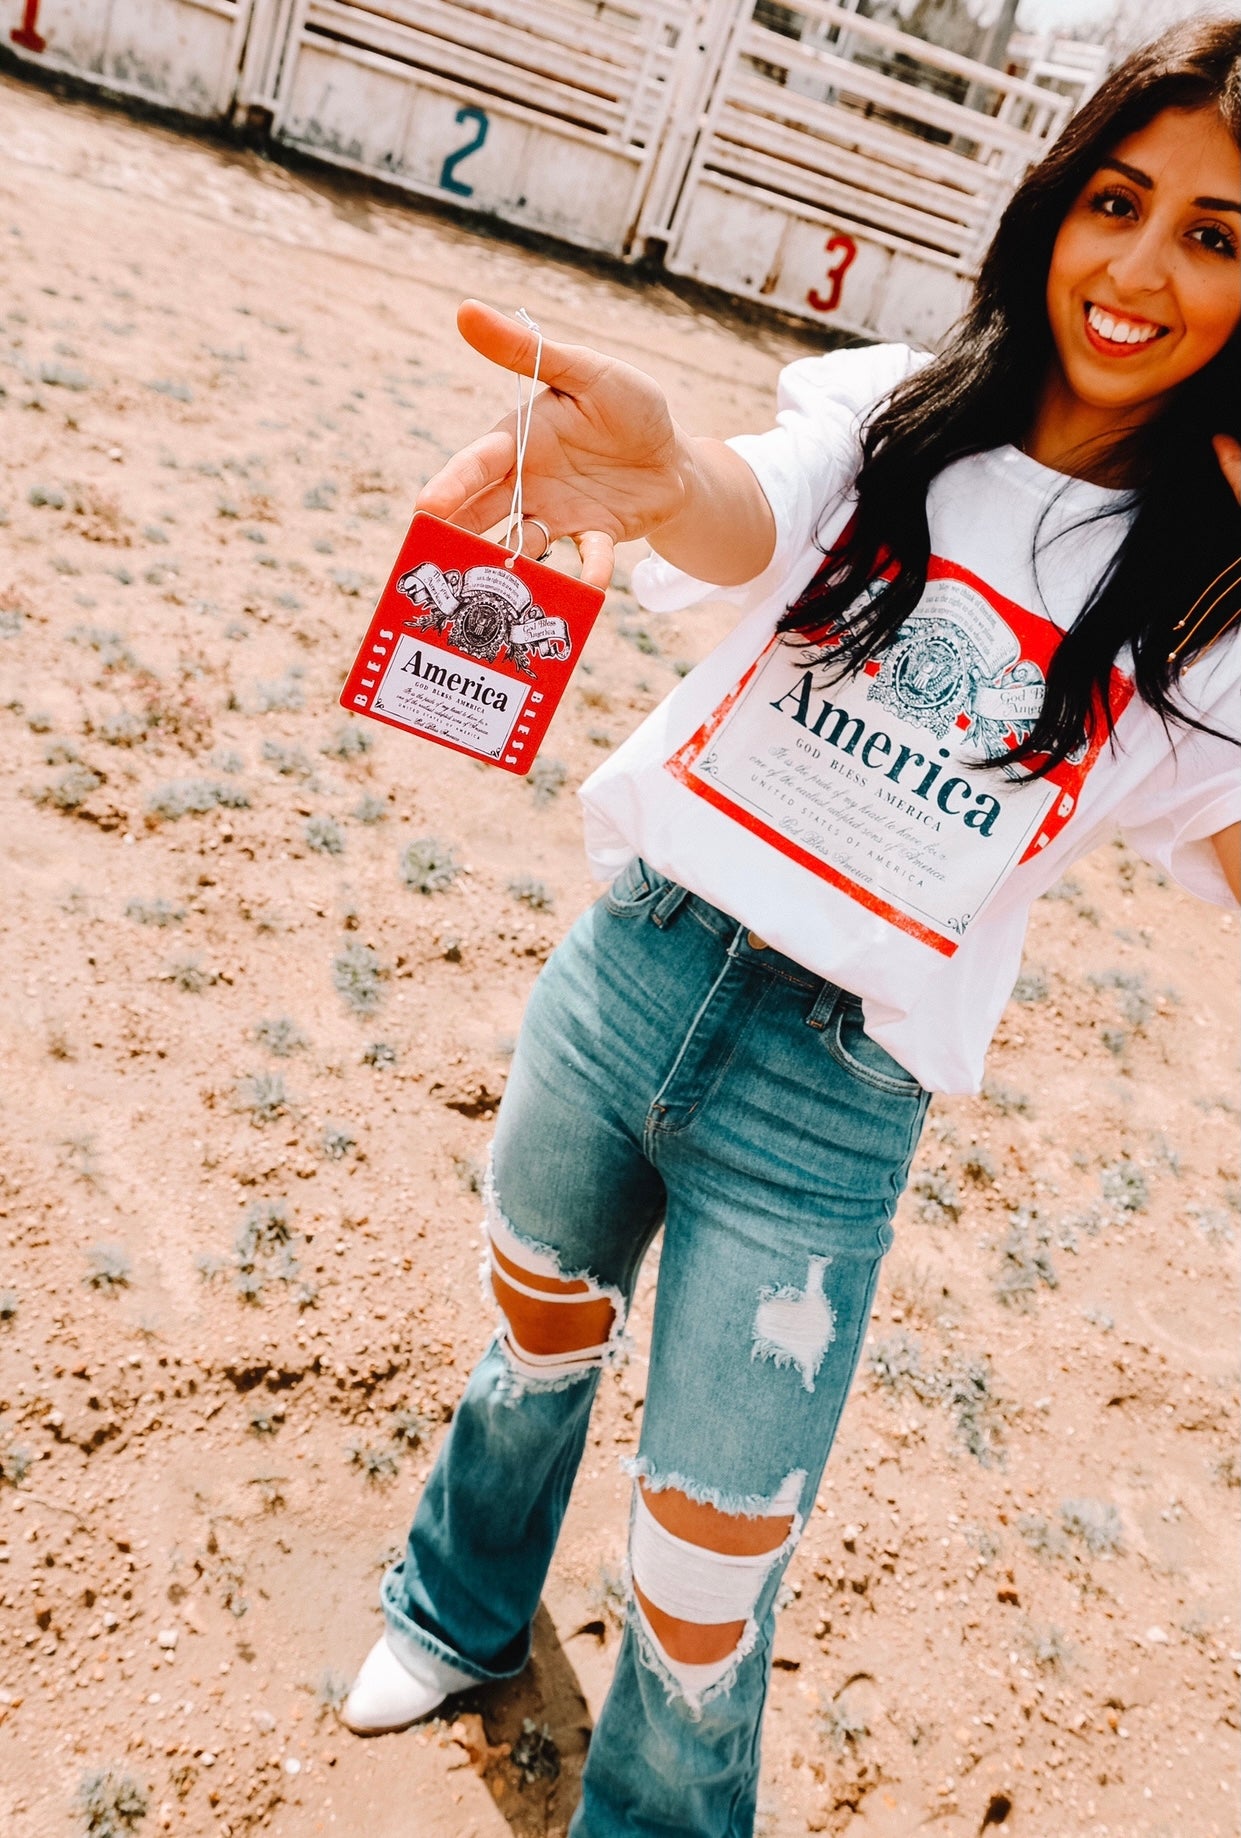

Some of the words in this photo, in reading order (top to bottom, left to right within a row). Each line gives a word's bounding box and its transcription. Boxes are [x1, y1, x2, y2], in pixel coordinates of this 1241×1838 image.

[440, 105, 490, 197] 2
[807, 235, 858, 312] 3
[353, 628, 394, 708] BLESS
[401, 650, 507, 713] America
[414, 681, 429, 691] GOD
[432, 688, 452, 700] BLESS
[456, 698, 485, 714] AMERICA
[1000, 689, 1026, 704] God
[505, 690, 544, 765] BLESS
[1003, 703, 1042, 717] Amer
[769, 670, 1002, 838] America
[795, 738, 821, 759] GOD
[830, 759, 868, 787] BLESS
[874, 788, 941, 832] AMERICA
[749, 756, 767, 768] one
[766, 768, 787, 778] of
[780, 775, 795, 787] the
[861, 828, 884, 844] sons
[884, 842, 902, 853] of
[751, 774, 795, 806] UNITED
[801, 807, 840, 836] STATES
[846, 836, 860, 848] OF
[867, 850, 924, 888] AMERICA
[768, 746, 790, 759] It
[795, 764, 810, 776] the
[807, 774, 833, 791] pride
[832, 789, 850, 799] of
[843, 796, 858, 809] my
[858, 803, 888, 822] heart
[884, 820, 897, 830] to
[896, 826, 922, 844] have
[779, 816, 804, 835] God
[800, 831, 829, 855] Bless
[832, 853, 873, 883] America
